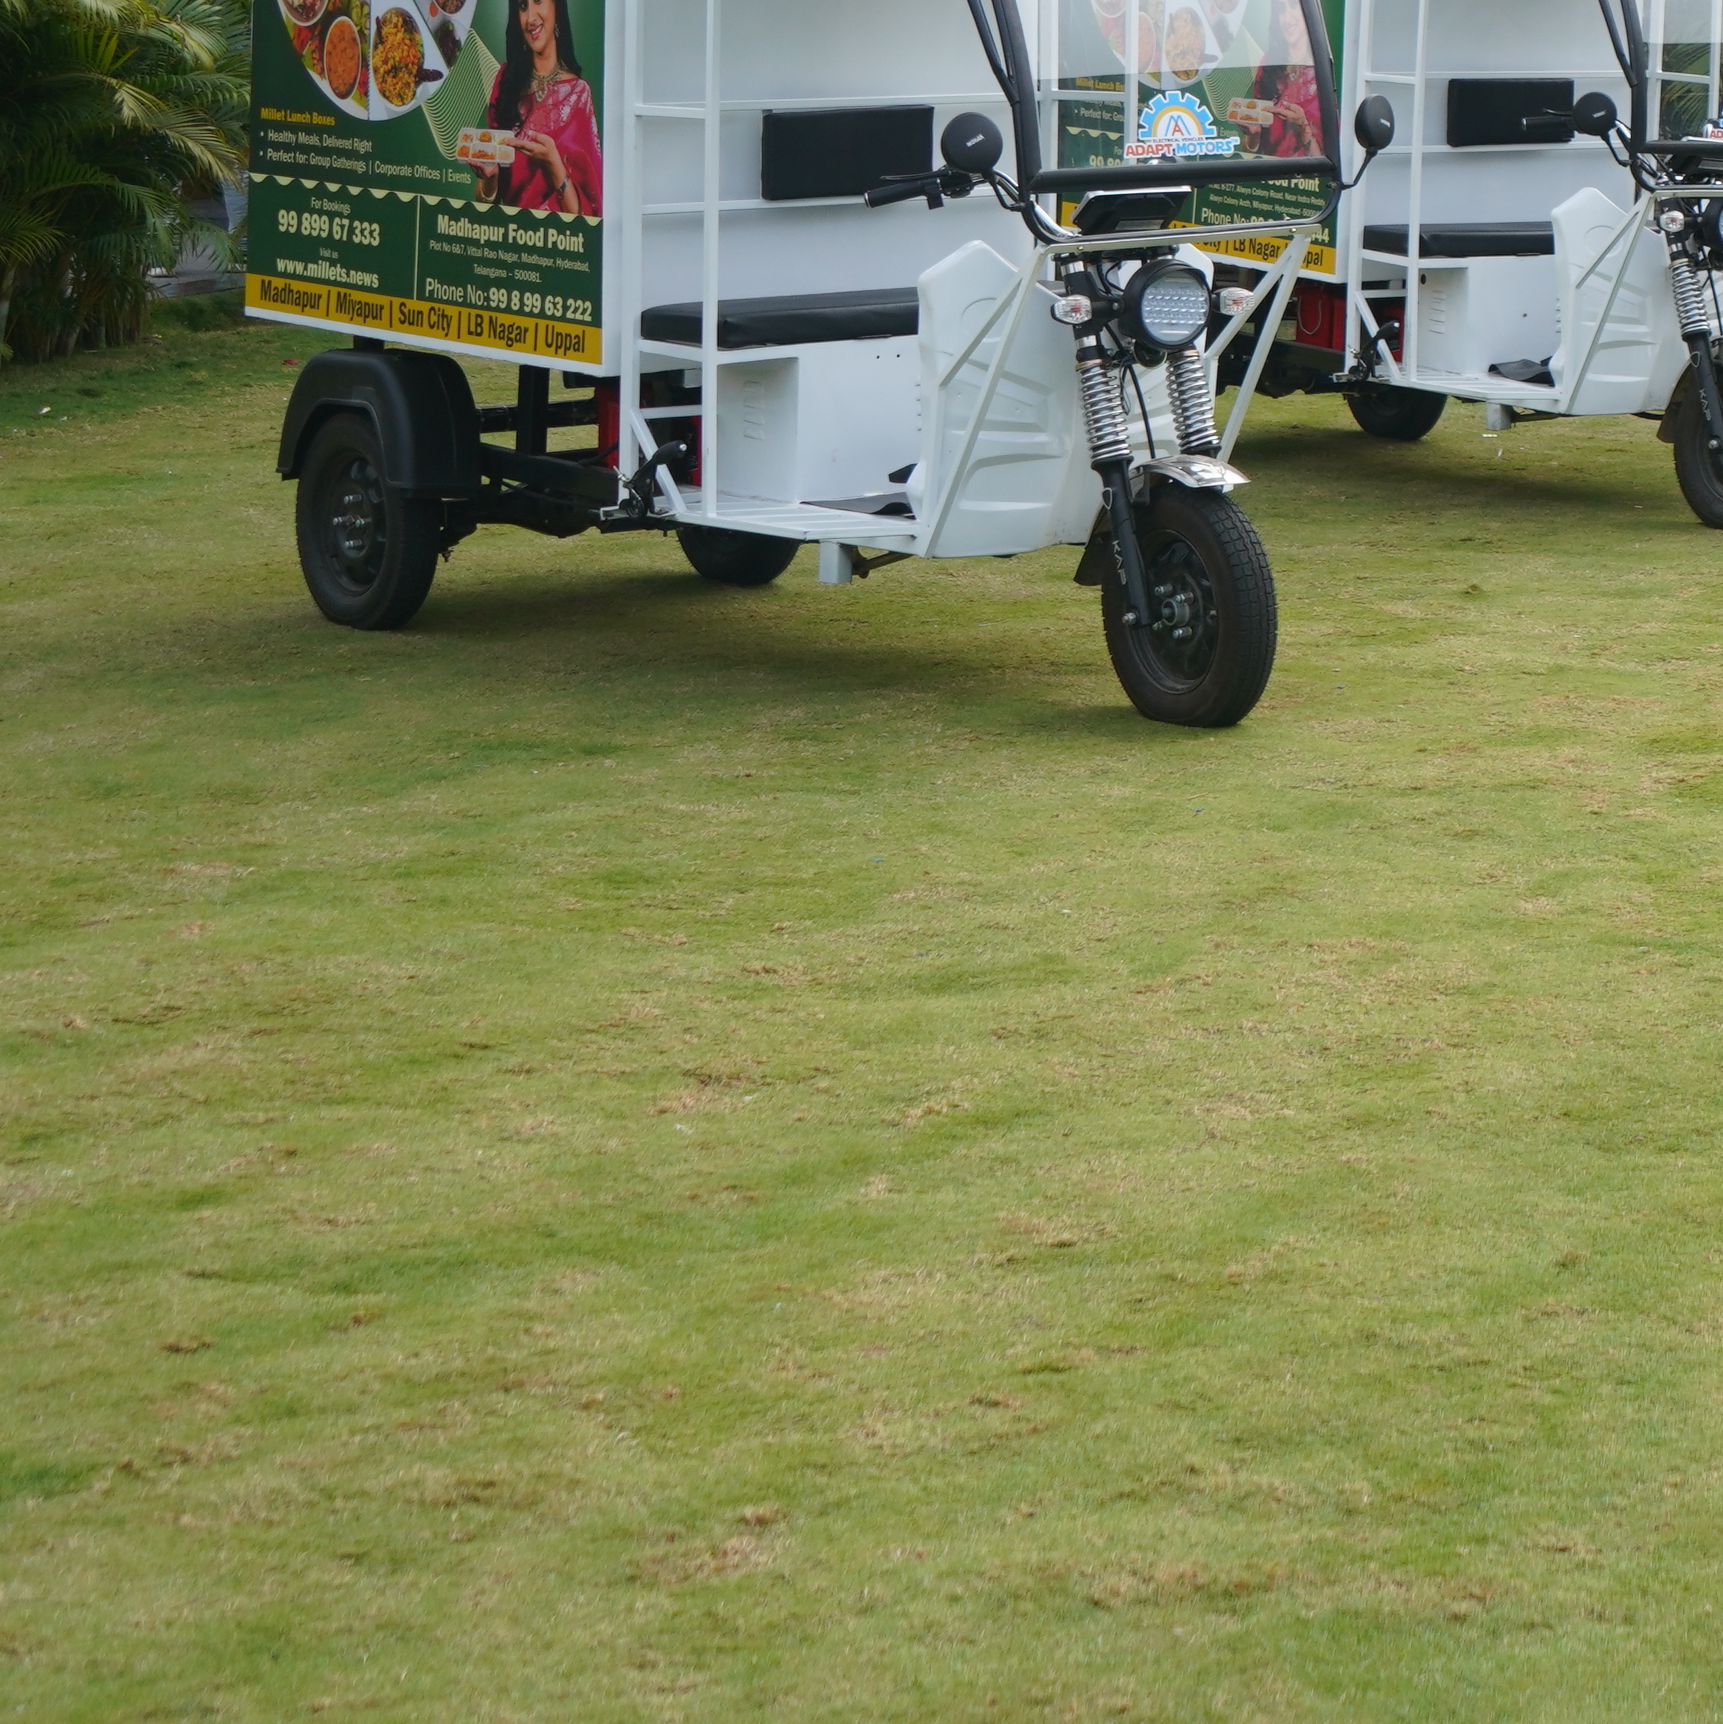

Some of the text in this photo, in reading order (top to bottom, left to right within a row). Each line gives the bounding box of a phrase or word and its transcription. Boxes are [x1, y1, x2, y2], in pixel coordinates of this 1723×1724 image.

[261, 107, 335, 125] Millet Lunch Boxes
[267, 129, 372, 154] Healthy Meals, Delivered Right
[1126, 140, 1233, 156] ADAPT MOTORS
[267, 148, 471, 184] Perfect for: Group Gatherings Corporate Offices Events
[278, 209, 381, 247] 99 899 67 333
[437, 214, 584, 253] Madhapur Food Point
[276, 254, 379, 289] www.millets.news
[425, 278, 487, 306] Phone No:
[260, 273, 586, 353] Madhapur Miyapur Sun City LB Nagar Uppal
